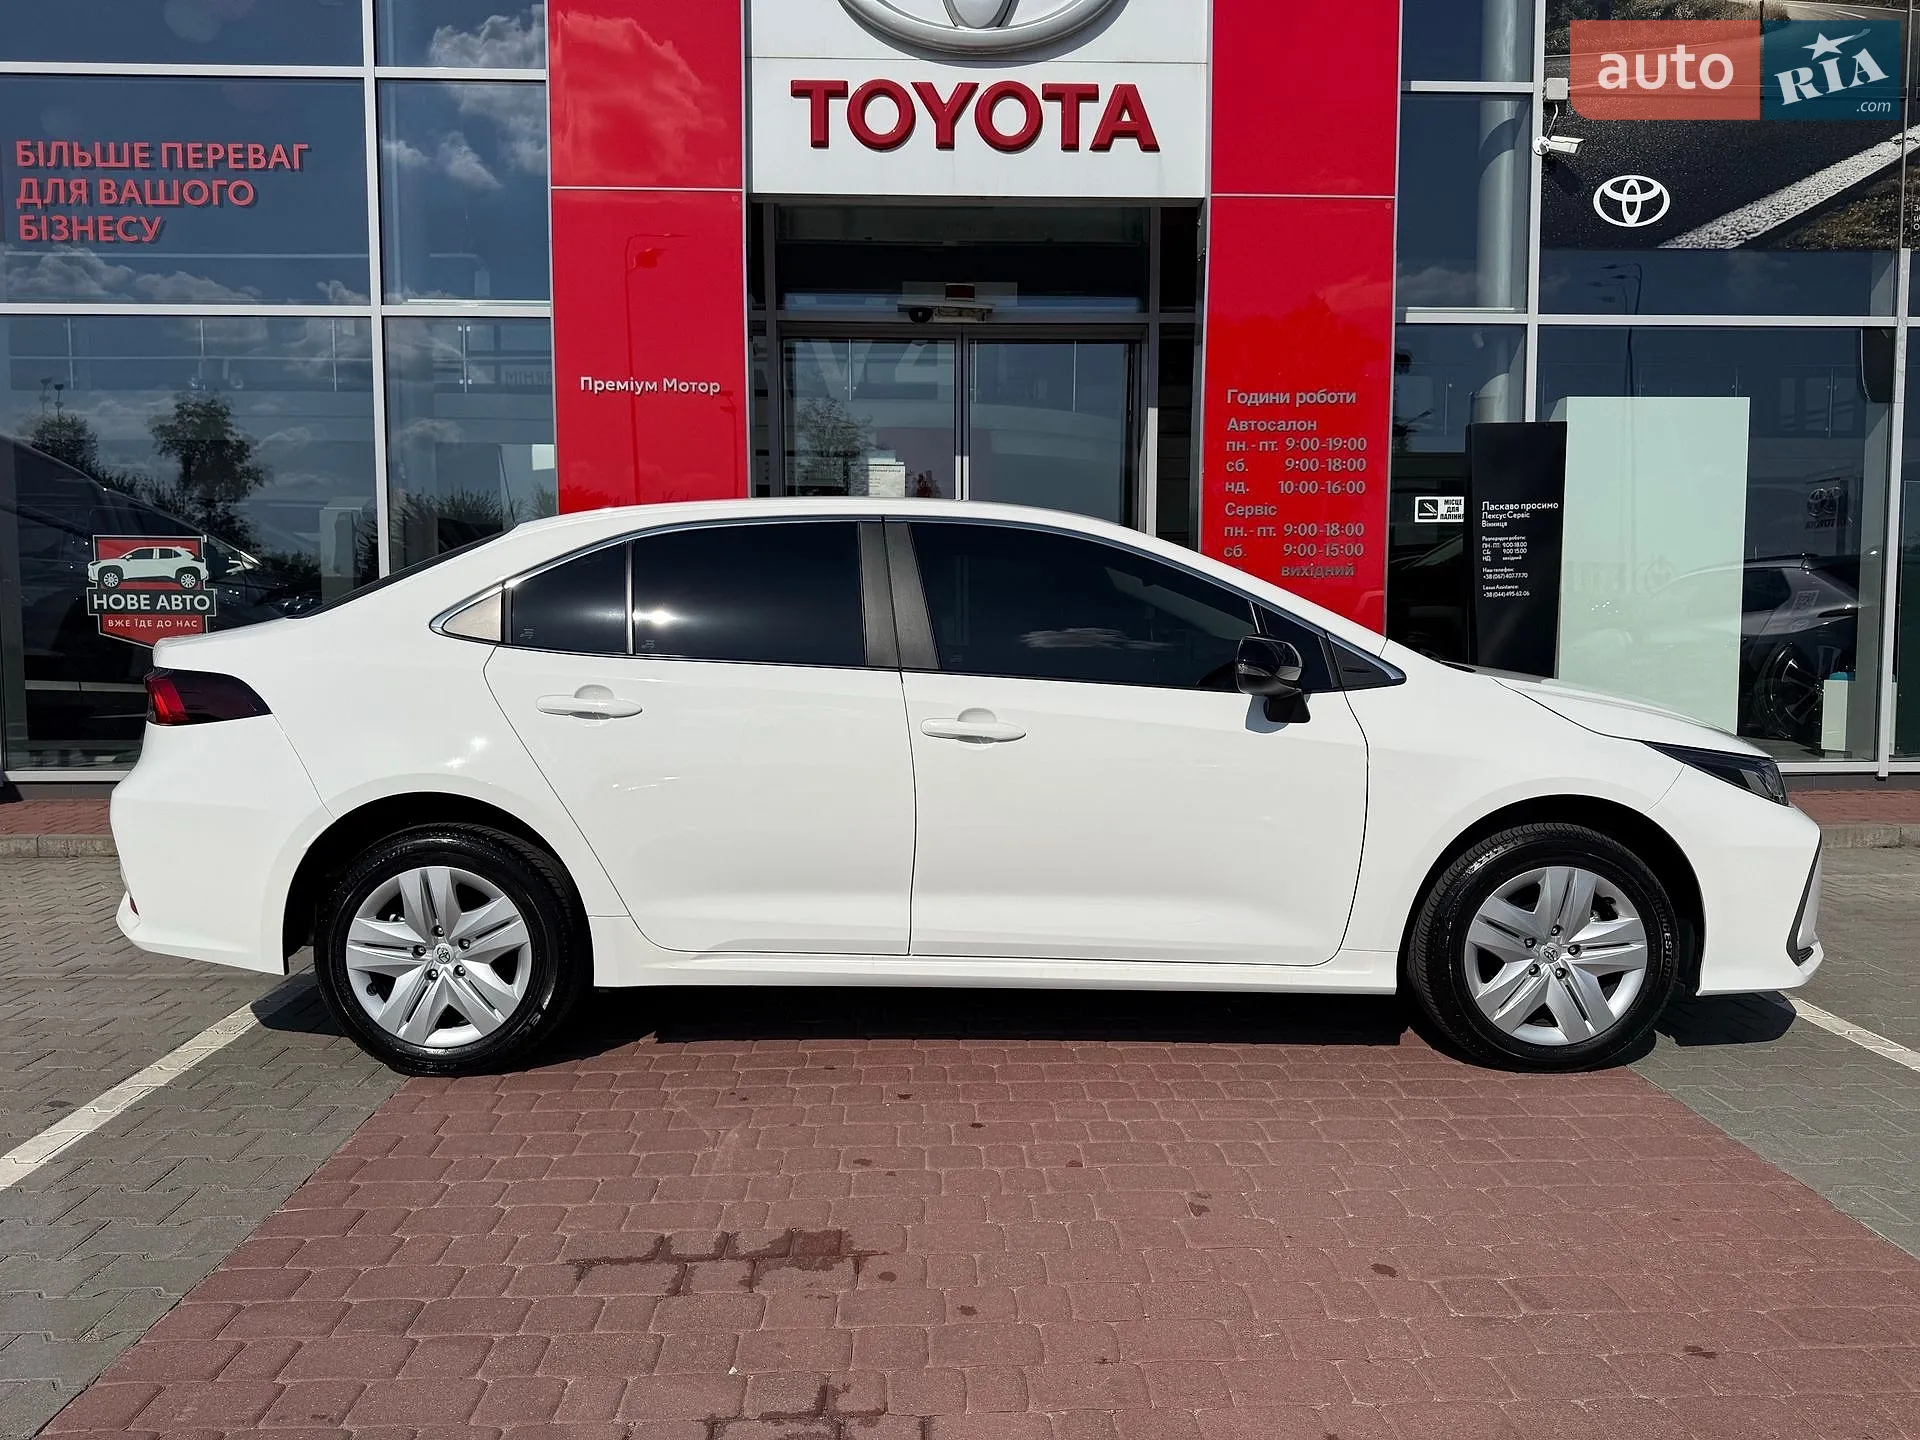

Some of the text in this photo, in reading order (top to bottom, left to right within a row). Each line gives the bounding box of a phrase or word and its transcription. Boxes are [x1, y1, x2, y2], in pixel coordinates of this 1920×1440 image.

[790, 78, 1161, 153] TOYOTA
[16, 141, 309, 170] БІЛЬШЕ ПЕРЕВАГ
[16, 177, 255, 210] ДЛЯ ВАШОГО
[19, 214, 162, 242] БІЗНЕСУ
[580, 376, 721, 396] Преміум Мотор
[1227, 388, 1357, 407] Години роботи
[1227, 417, 1317, 432] Автосалон
[1226, 458, 1249, 472] сб.
[1225, 481, 1250, 494] нд.
[1225, 502, 1278, 518] Сервіс
[1482, 501, 1559, 511] Ласкаво просимо
[1482, 511, 1531, 520] Лексус Сервіс
[1224, 544, 1247, 557] сб.
[1281, 562, 1355, 579] вихідний
[93, 594, 211, 611] НОВЕ АВТО
[108, 618, 198, 629] ВЖЕ ЇДЕ ДО НАС
